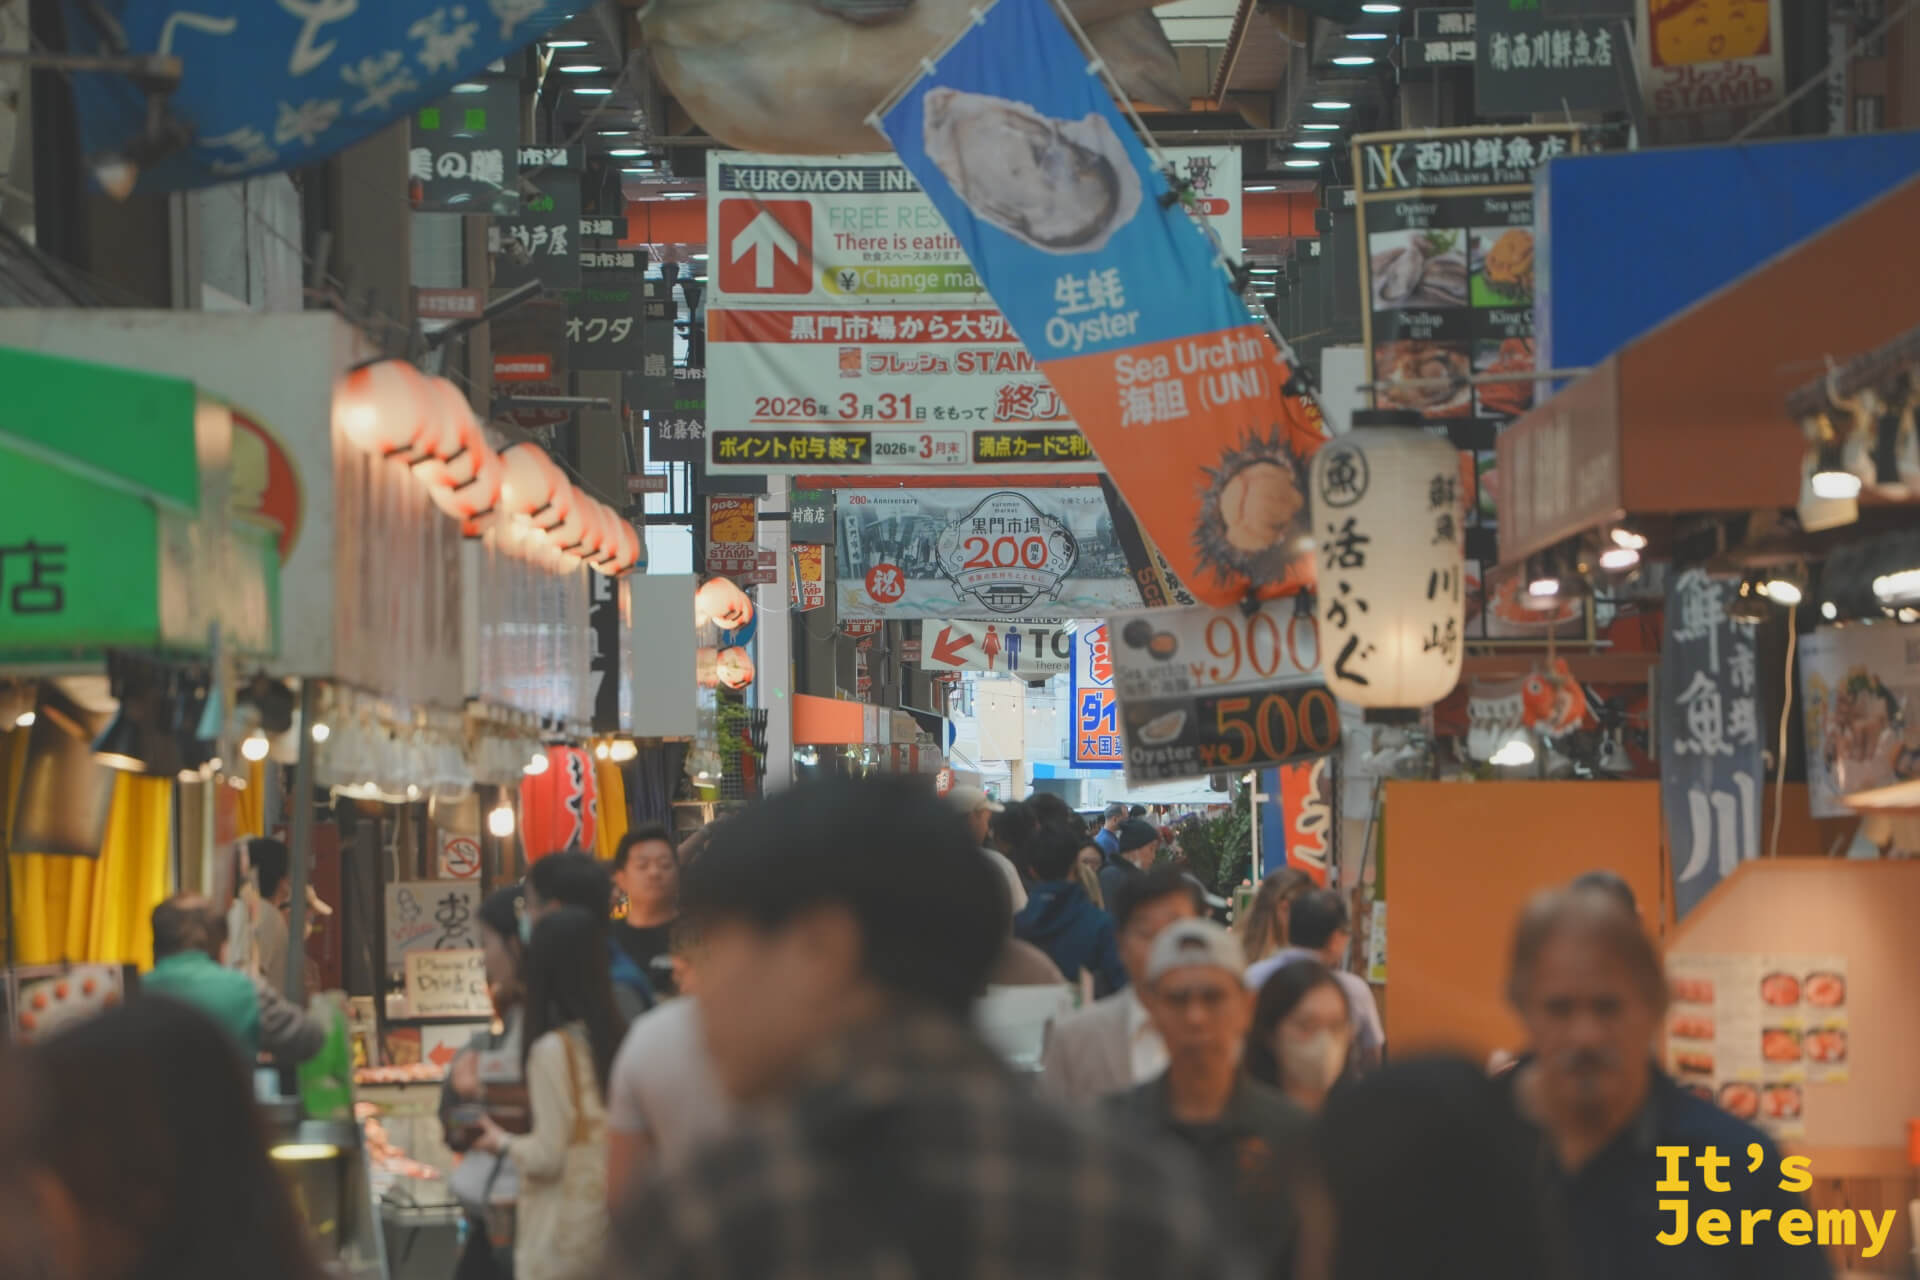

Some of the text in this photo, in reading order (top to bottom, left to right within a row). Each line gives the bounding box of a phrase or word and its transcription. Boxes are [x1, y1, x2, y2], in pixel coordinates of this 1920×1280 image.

[1653, 79, 1774, 113] STAMP
[734, 169, 864, 191] KUROMON
[829, 206, 888, 231] FREE
[834, 233, 887, 250] There
[893, 233, 907, 250] is
[863, 269, 938, 292] Change
[565, 317, 634, 343] オクダ
[1045, 310, 1140, 351] Oyster
[869, 354, 949, 373] フレッシュ
[1115, 331, 1263, 386] Sea Urchin
[719, 437, 867, 459] ポイント付与終了
[971, 516, 1041, 535] 黒門市場
[709, 549, 755, 559] STAMP
[962, 535, 1048, 570] 200
